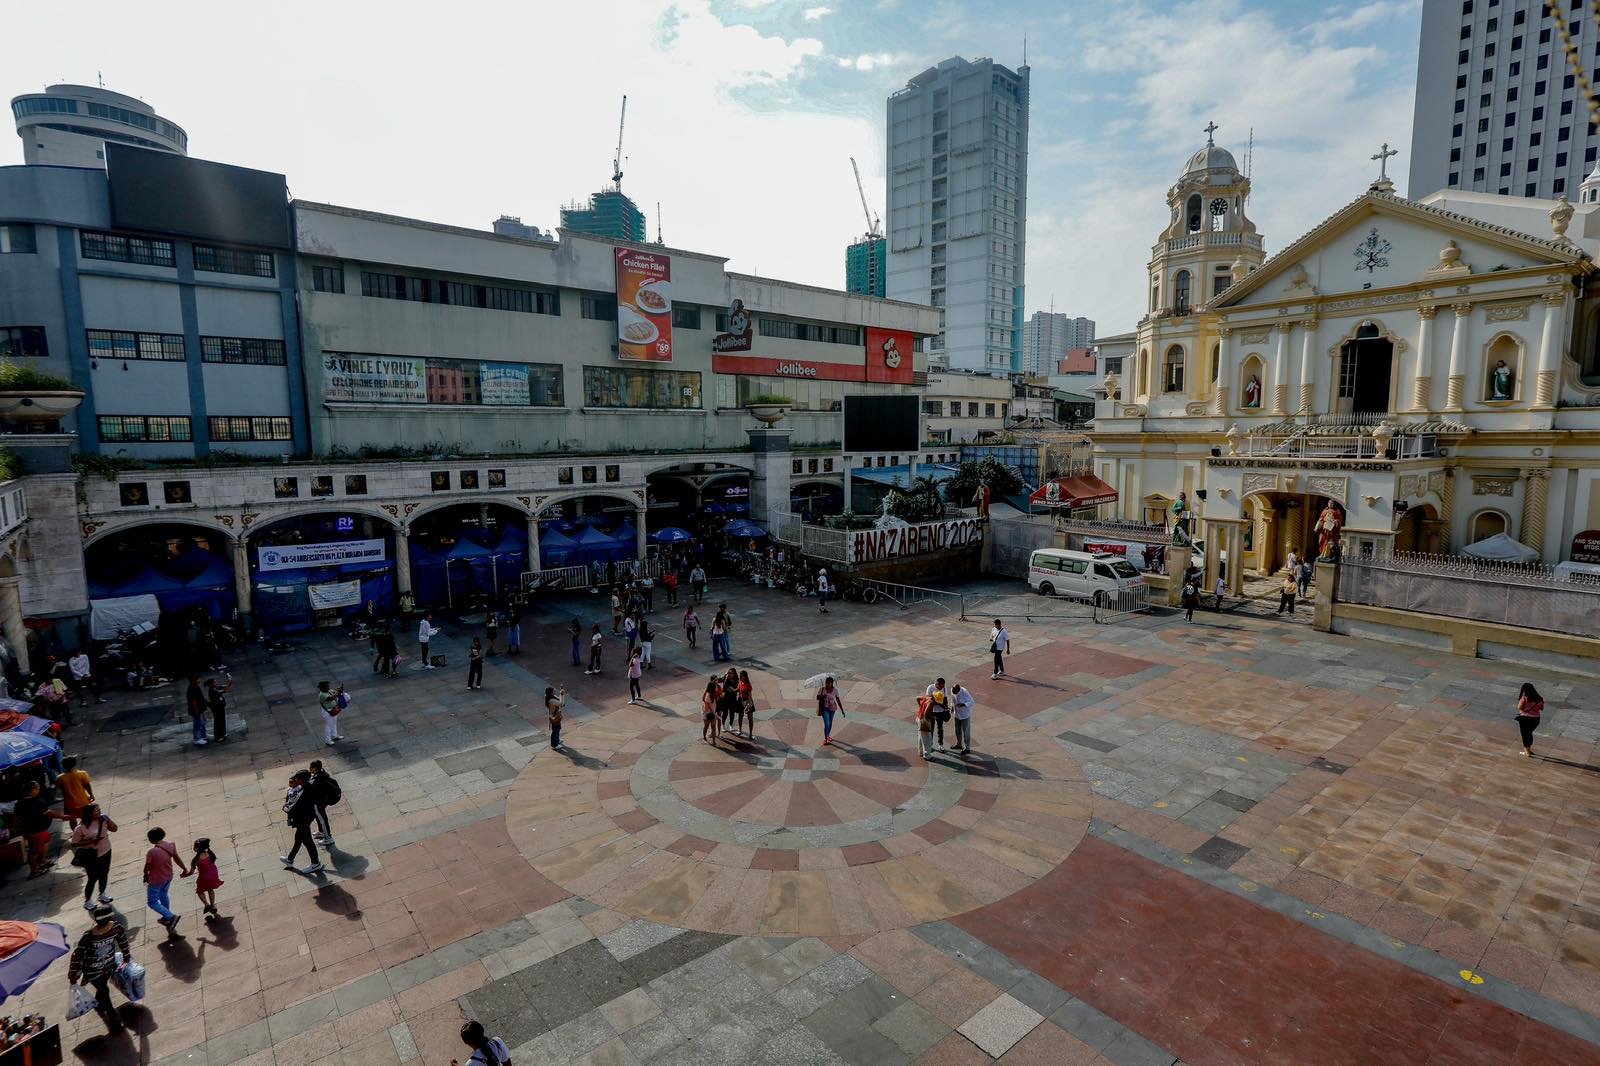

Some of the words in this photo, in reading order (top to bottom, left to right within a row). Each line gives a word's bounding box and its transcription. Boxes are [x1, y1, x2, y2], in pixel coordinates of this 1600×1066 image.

[623, 259, 650, 270] Chicken
[650, 263, 665, 272] Fillet
[718, 336, 747, 349] Jollibee
[339, 359, 373, 374] VINCE
[376, 360, 413, 376] CYRUZ
[776, 361, 816, 376] Jollibee
[374, 379, 400, 389] REPAIR
[1339, 462, 1393, 471] NAZARENO
